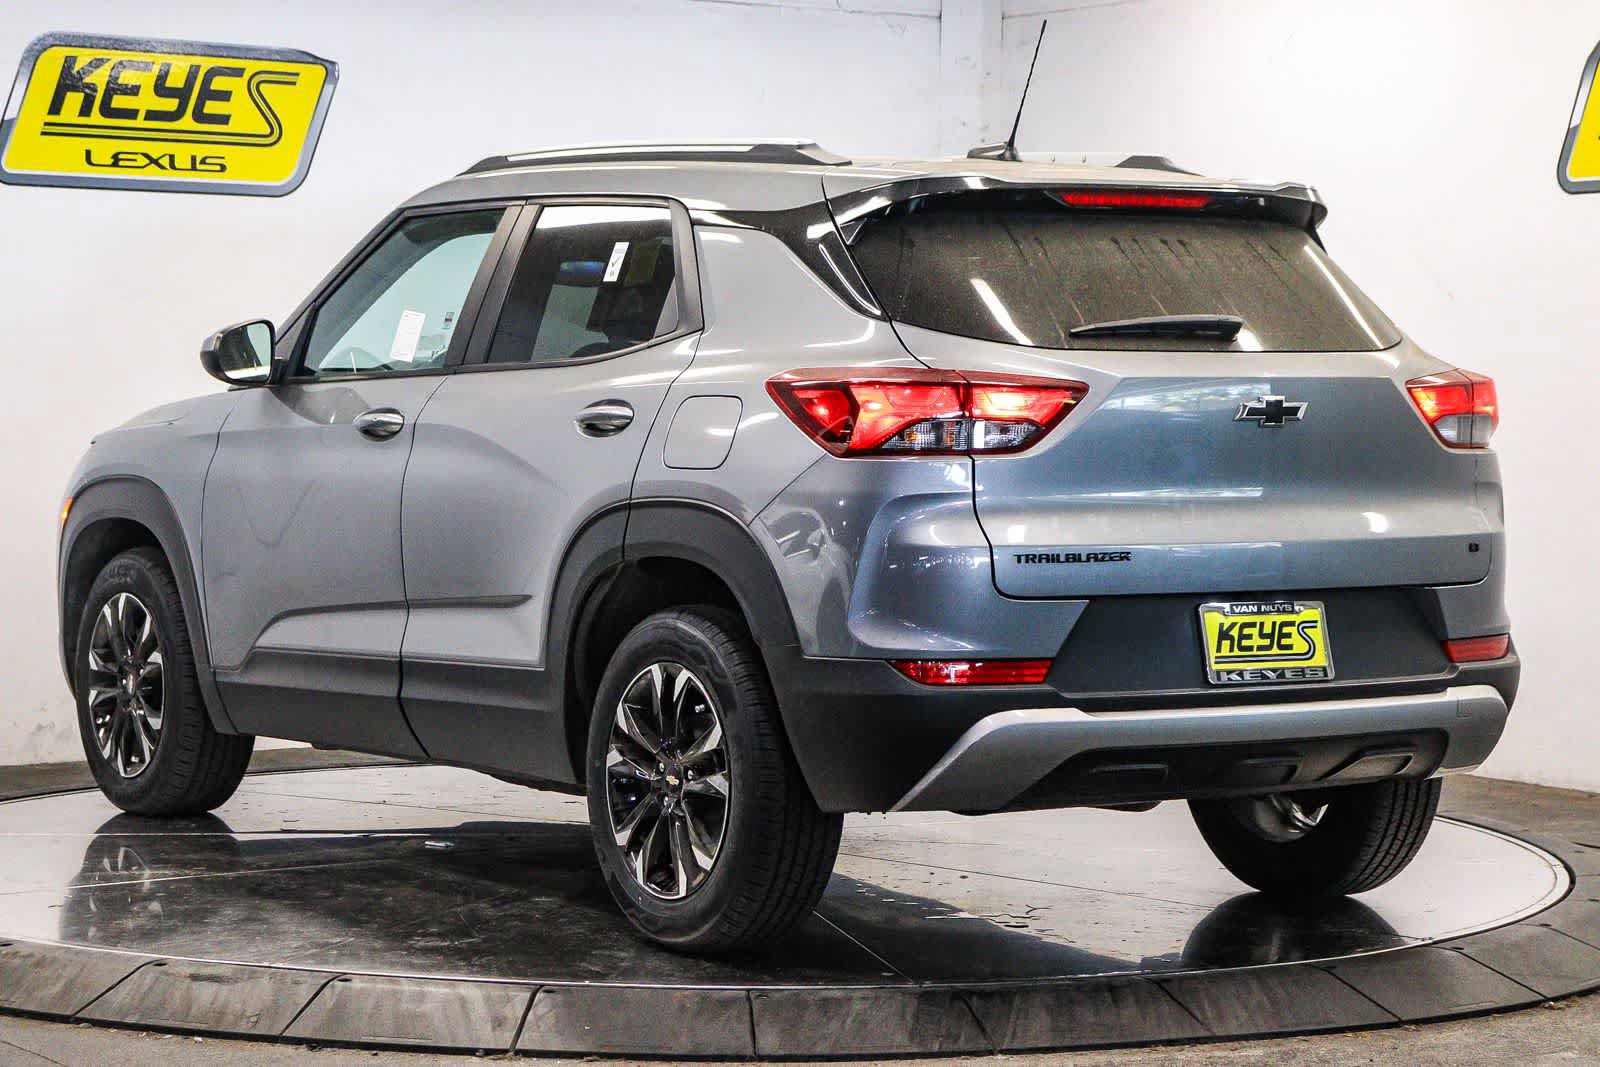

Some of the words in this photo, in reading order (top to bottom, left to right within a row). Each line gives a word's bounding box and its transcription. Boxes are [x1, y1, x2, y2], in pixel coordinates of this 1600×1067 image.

[43, 56, 300, 147] KEYES
[85, 149, 227, 173] LEXUS
[1013, 551, 1132, 564] TRAILBLAZER
[1232, 605, 1258, 613] VAN
[1261, 603, 1293, 612] NUYS
[1214, 620, 1319, 664] KEYES
[1219, 667, 1325, 682] KEYES
